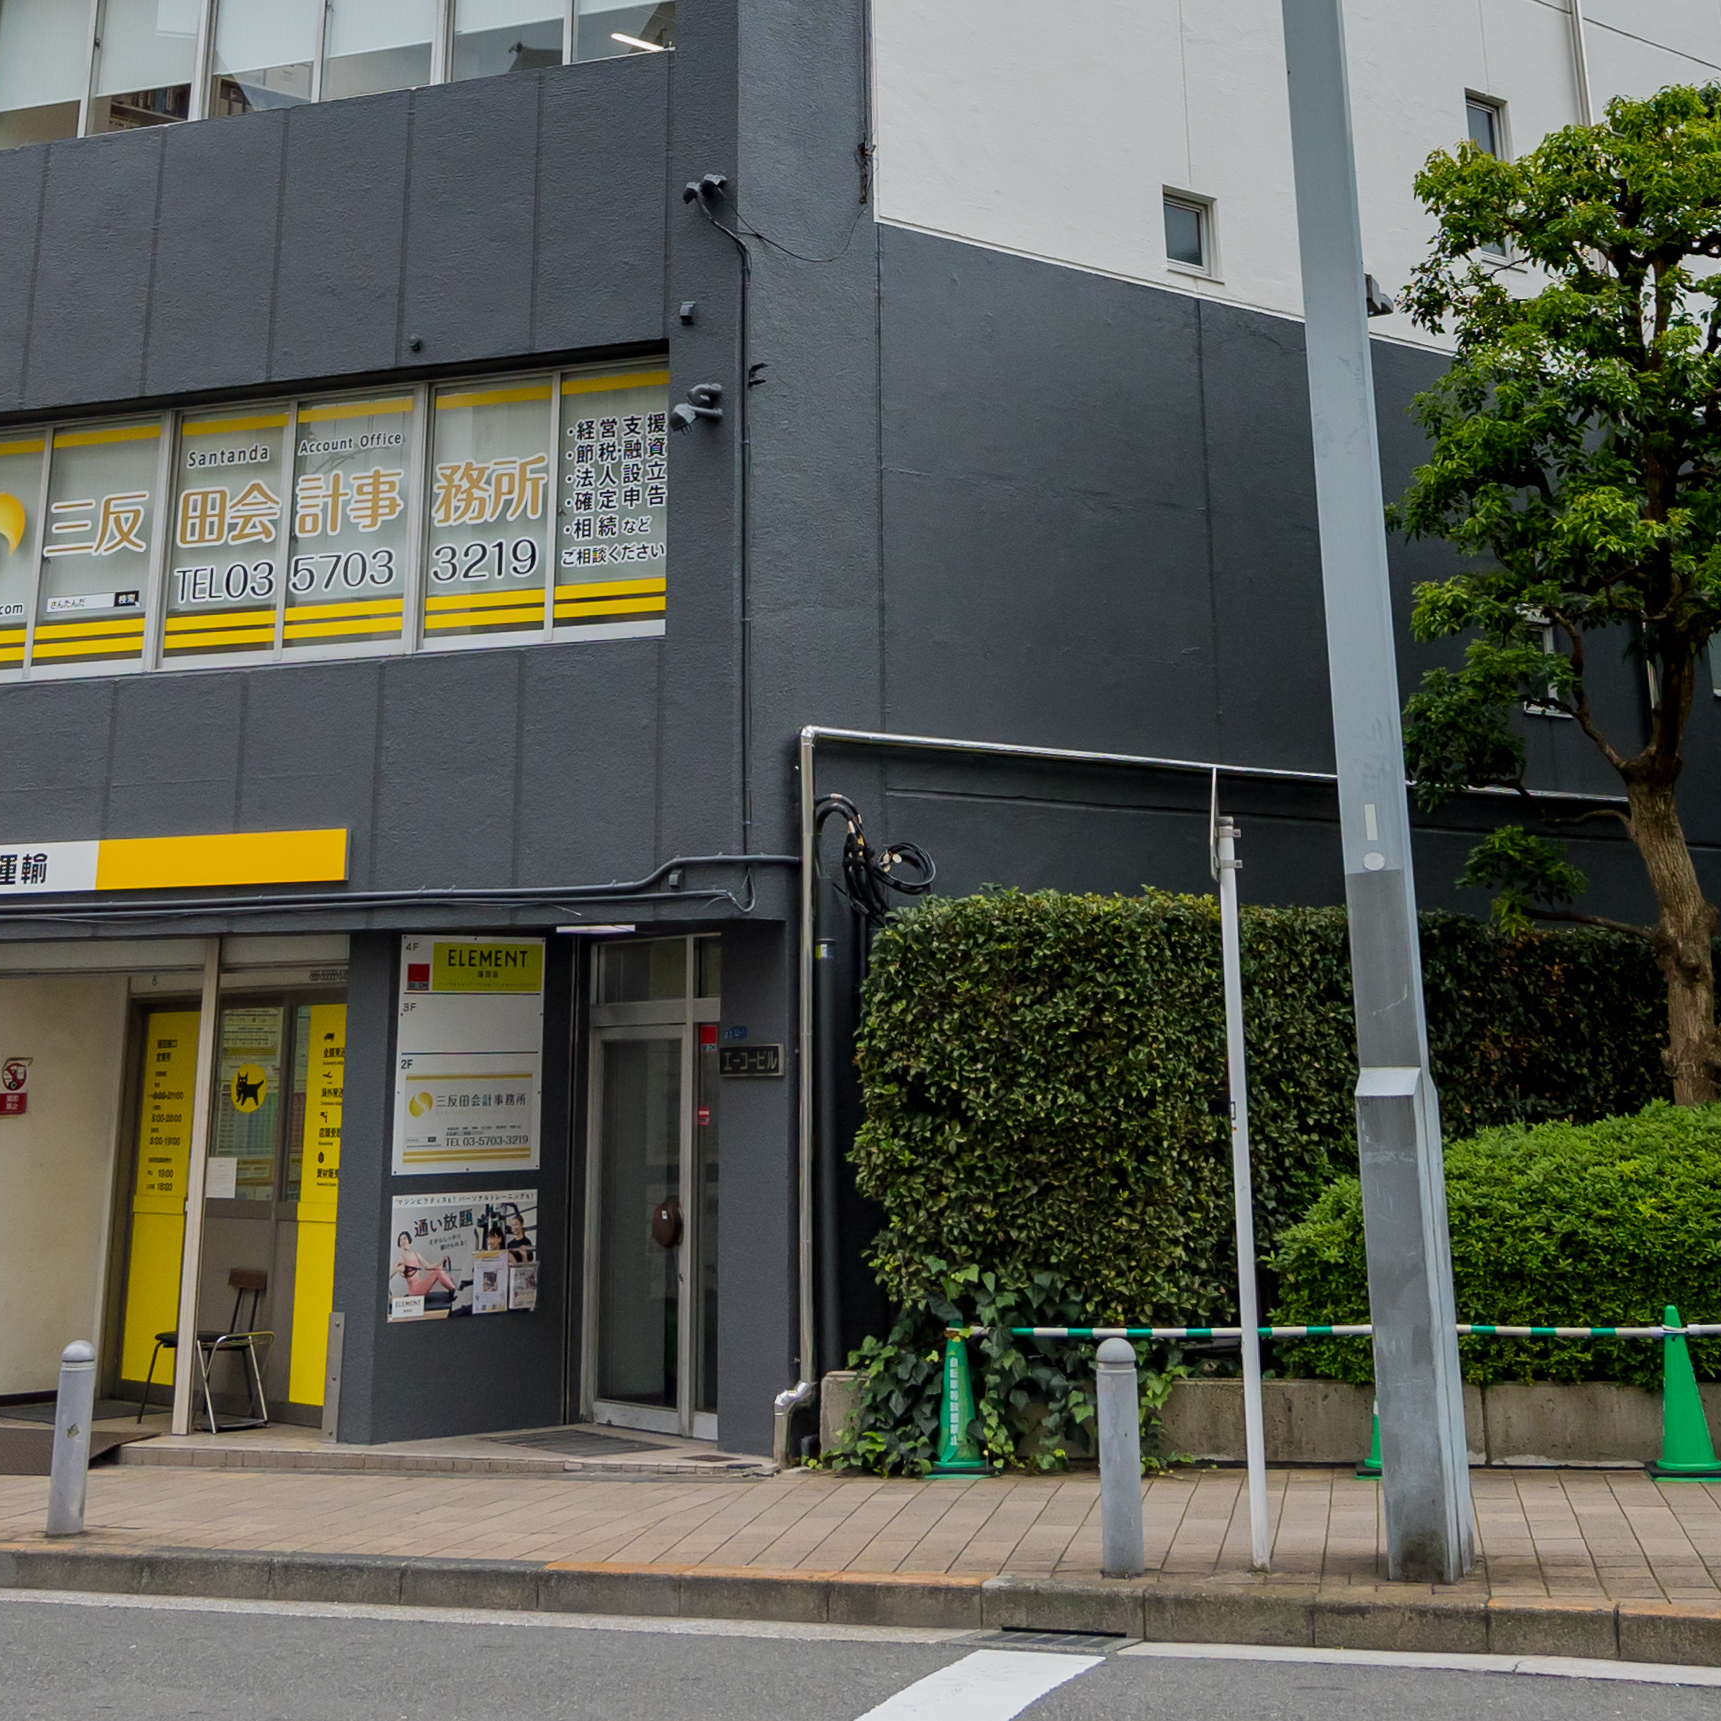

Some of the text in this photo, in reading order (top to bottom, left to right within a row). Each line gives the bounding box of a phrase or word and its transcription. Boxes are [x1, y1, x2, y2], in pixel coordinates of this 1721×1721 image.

[188, 432, 402, 468] Santanda Account Office
[44, 455, 546, 555] 三反田会計事務所
[290, 549, 394, 592] 5703
[432, 538, 537, 582] 3219
[562, 544, 665, 566] ご相談ください
[405, 942, 419, 951] 4F
[447, 949, 528, 968] ELEMENT
[402, 1002, 416, 1012] 3F
[400, 1059, 413, 1069] 2F
[723, 1050, 778, 1071] エーコービル
[436, 1093, 526, 1107] 三反田会計事務所
[446, 1137, 460, 1147] TEL
[463, 1134, 529, 1147] 03-5703-3219
[414, 1208, 474, 1238] 通い放題
